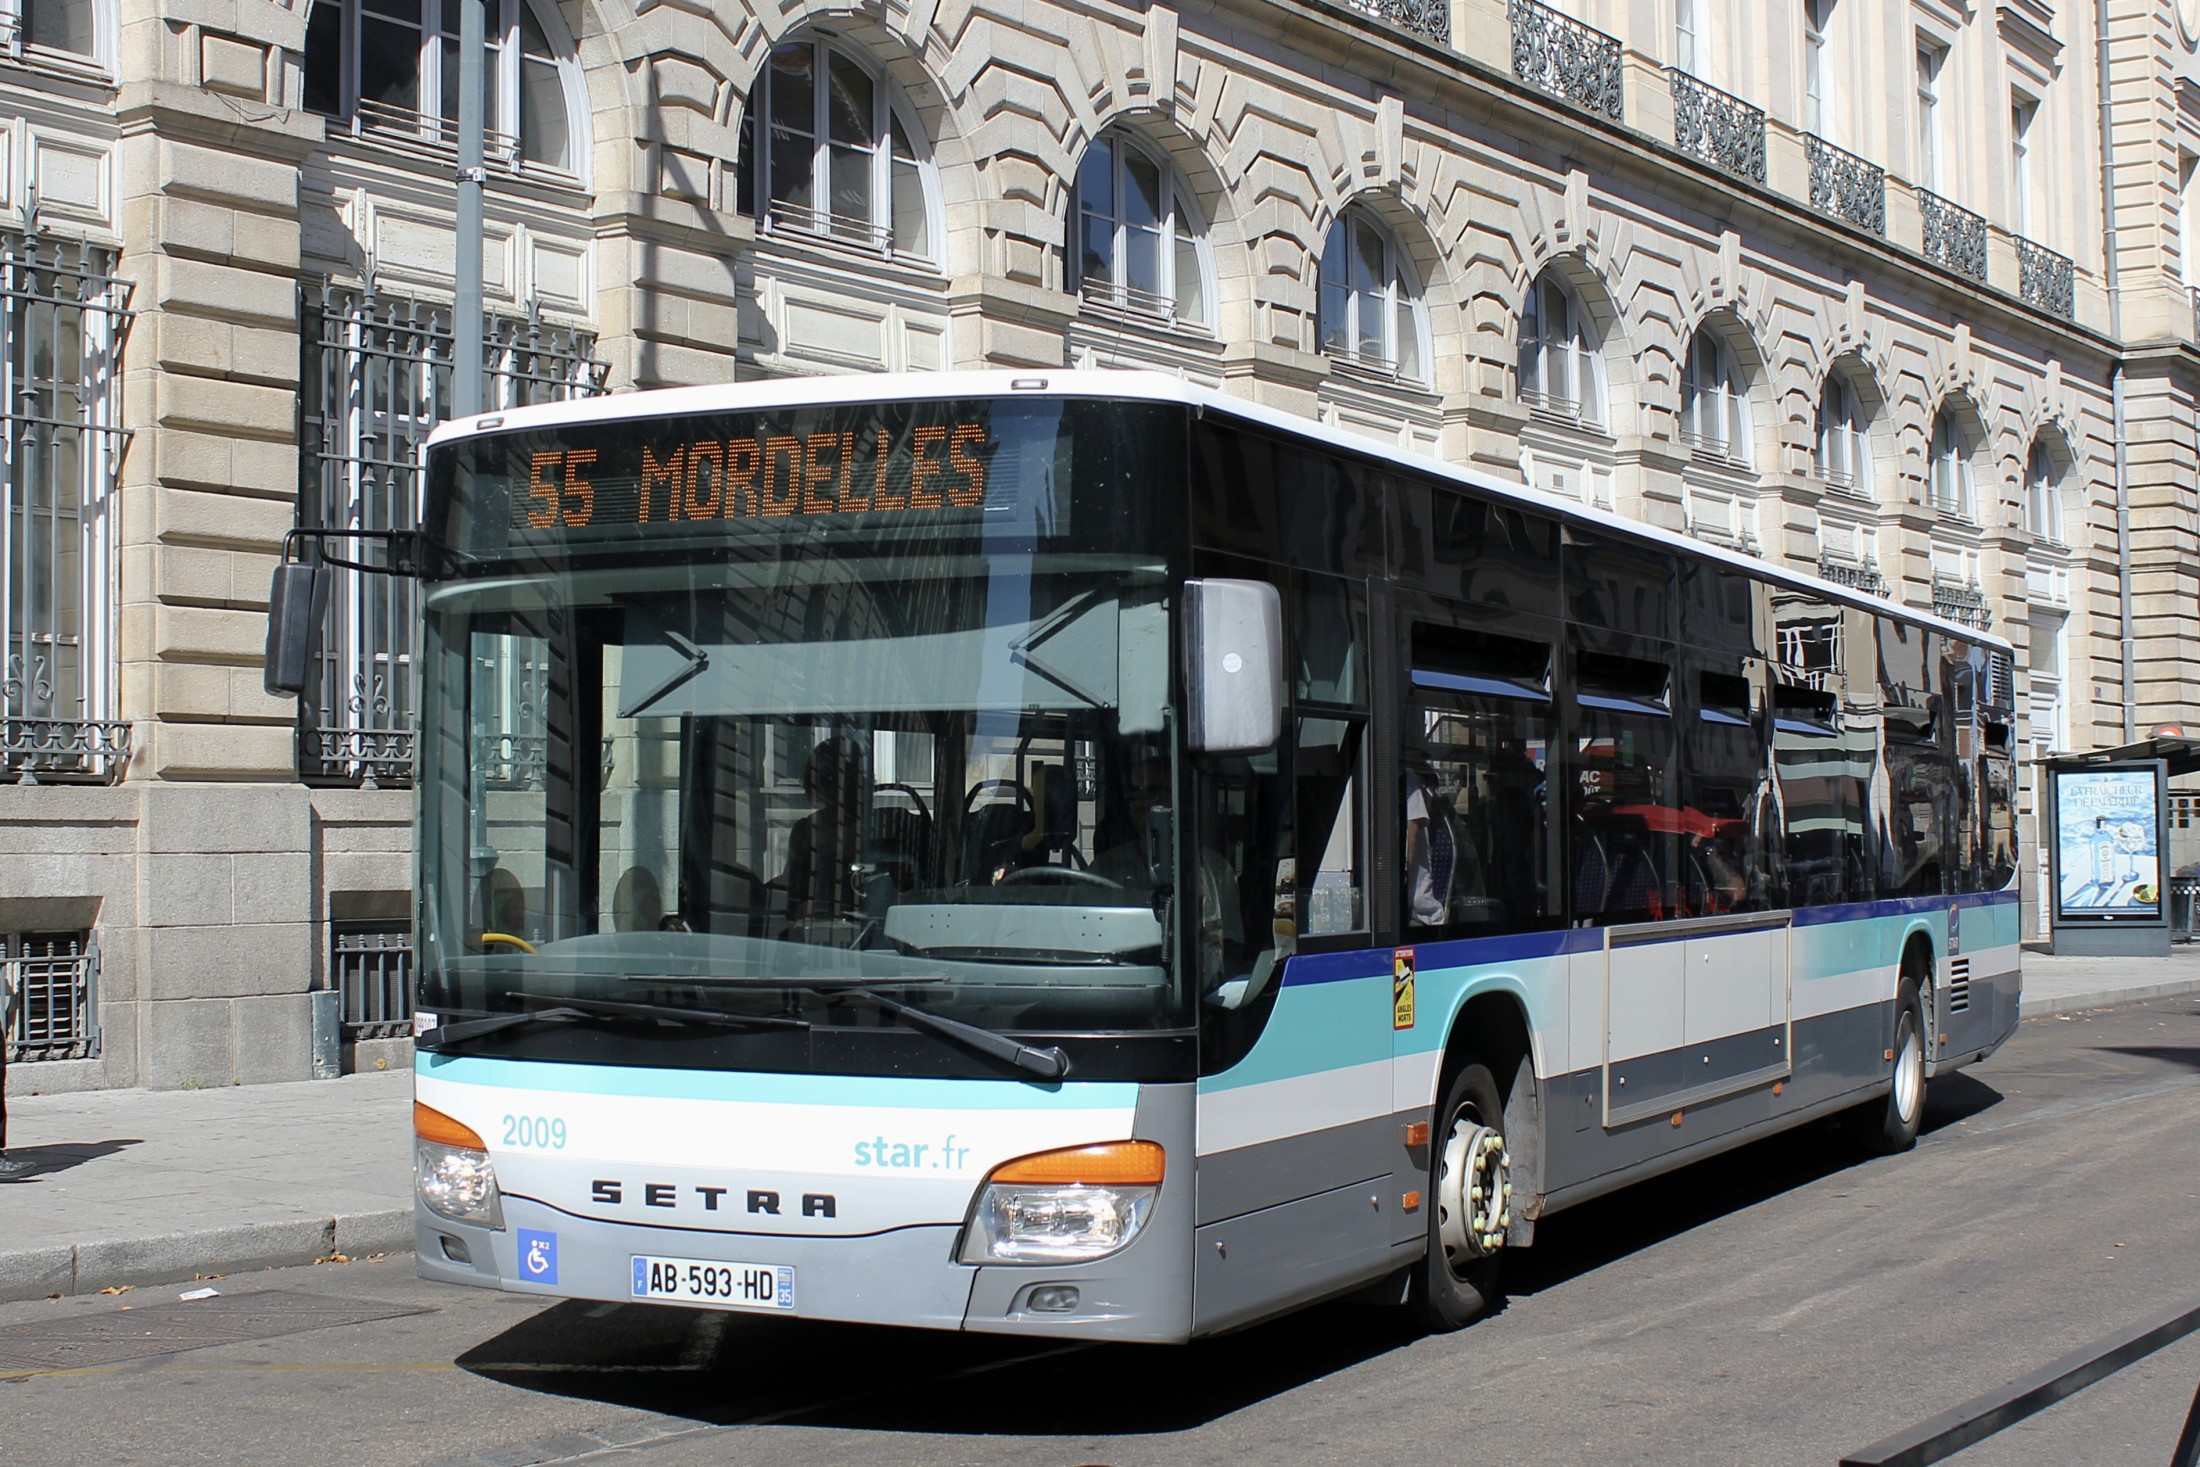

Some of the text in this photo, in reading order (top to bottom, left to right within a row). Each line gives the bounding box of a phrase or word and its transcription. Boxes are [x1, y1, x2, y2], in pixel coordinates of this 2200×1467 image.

[527, 423, 986, 528] 55 MORDELLES
[1397, 1004, 1412, 1013] ANGLES
[1398, 1014, 1412, 1022] MORTS
[502, 1114, 567, 1150] 2009
[854, 1134, 971, 1170] star.fr
[592, 1179, 837, 1219] SETRA
[637, 1280, 643, 1290] F
[650, 1262, 774, 1301] AB-593-HD
[778, 1288, 793, 1304] 35
